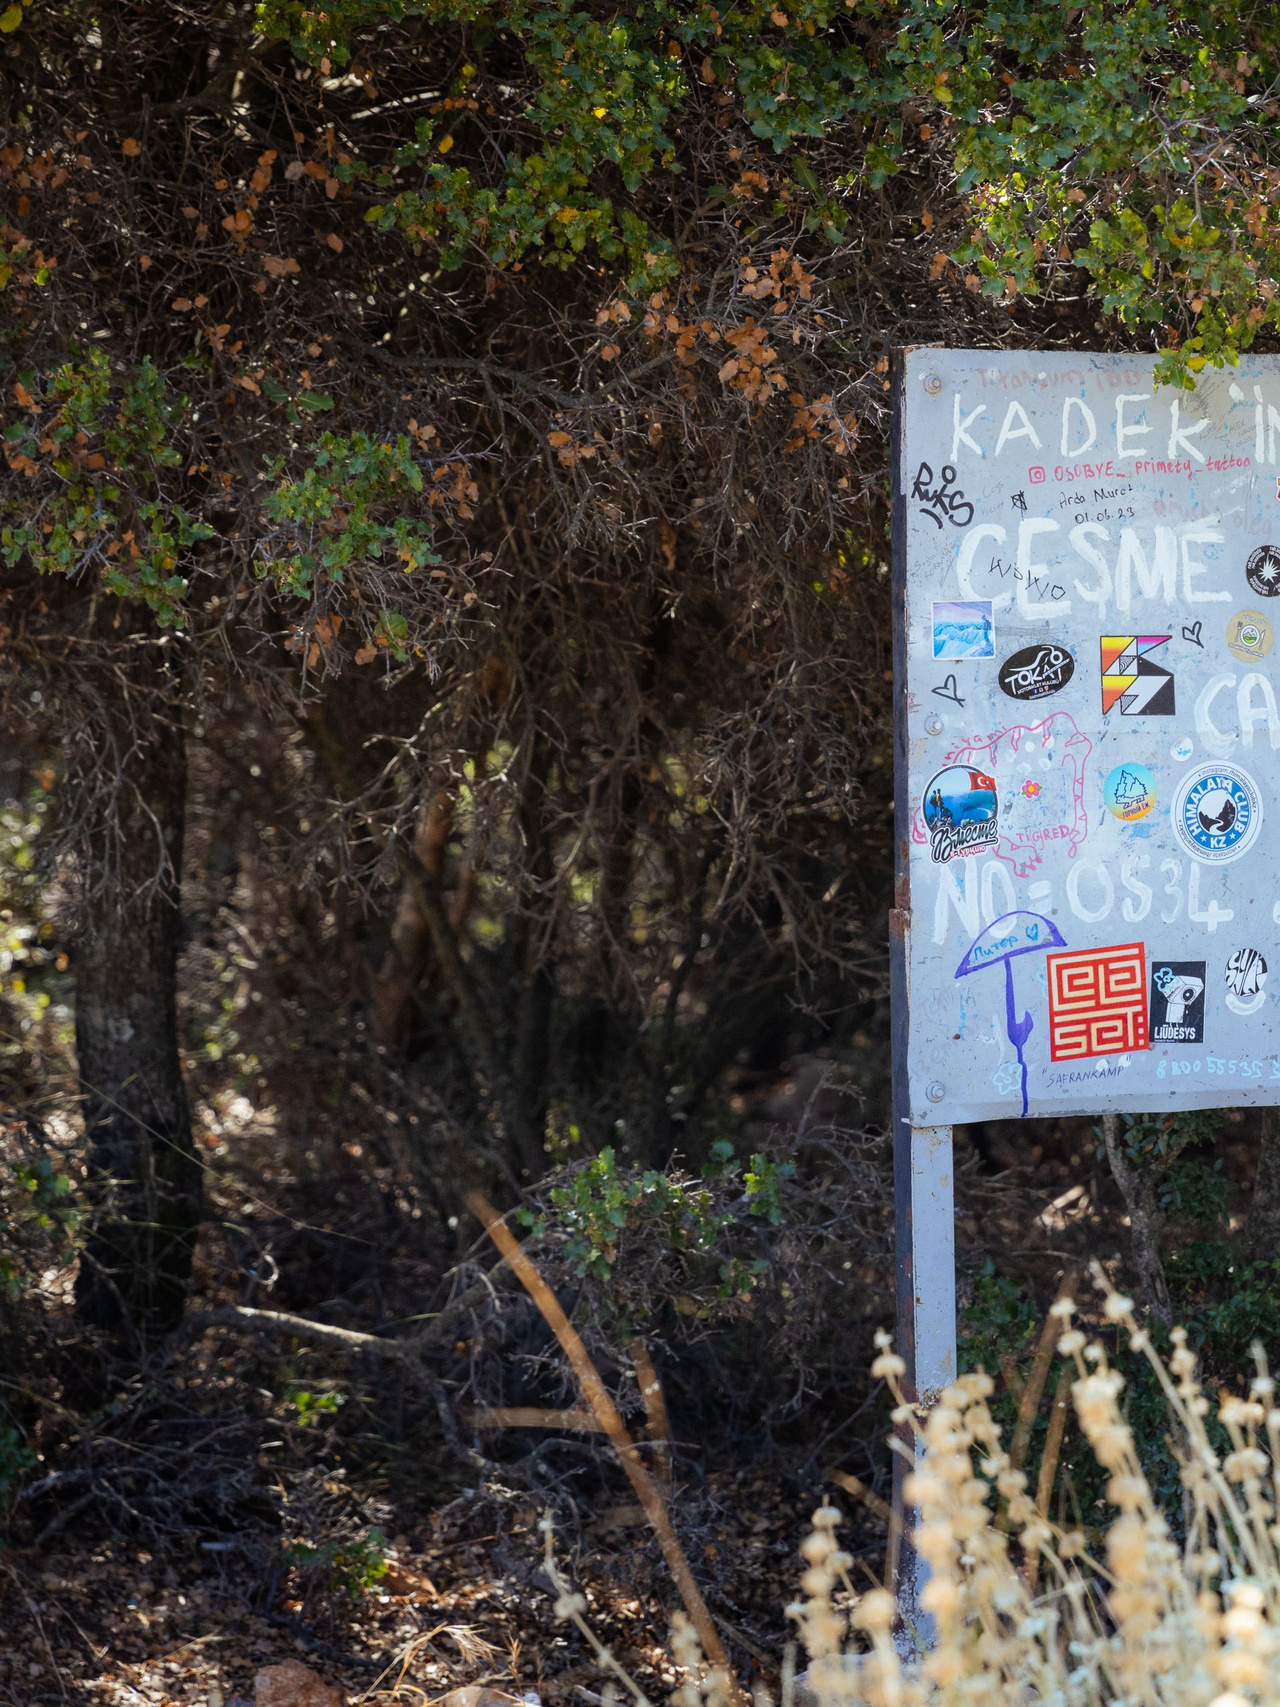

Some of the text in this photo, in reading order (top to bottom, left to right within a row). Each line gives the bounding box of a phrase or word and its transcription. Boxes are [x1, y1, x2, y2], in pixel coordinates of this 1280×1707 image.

[1075, 507, 1136, 524] 01.06.23
[1186, 776, 1249, 837] HIMALAYA CLUB
[1210, 836, 1227, 848] KZ
